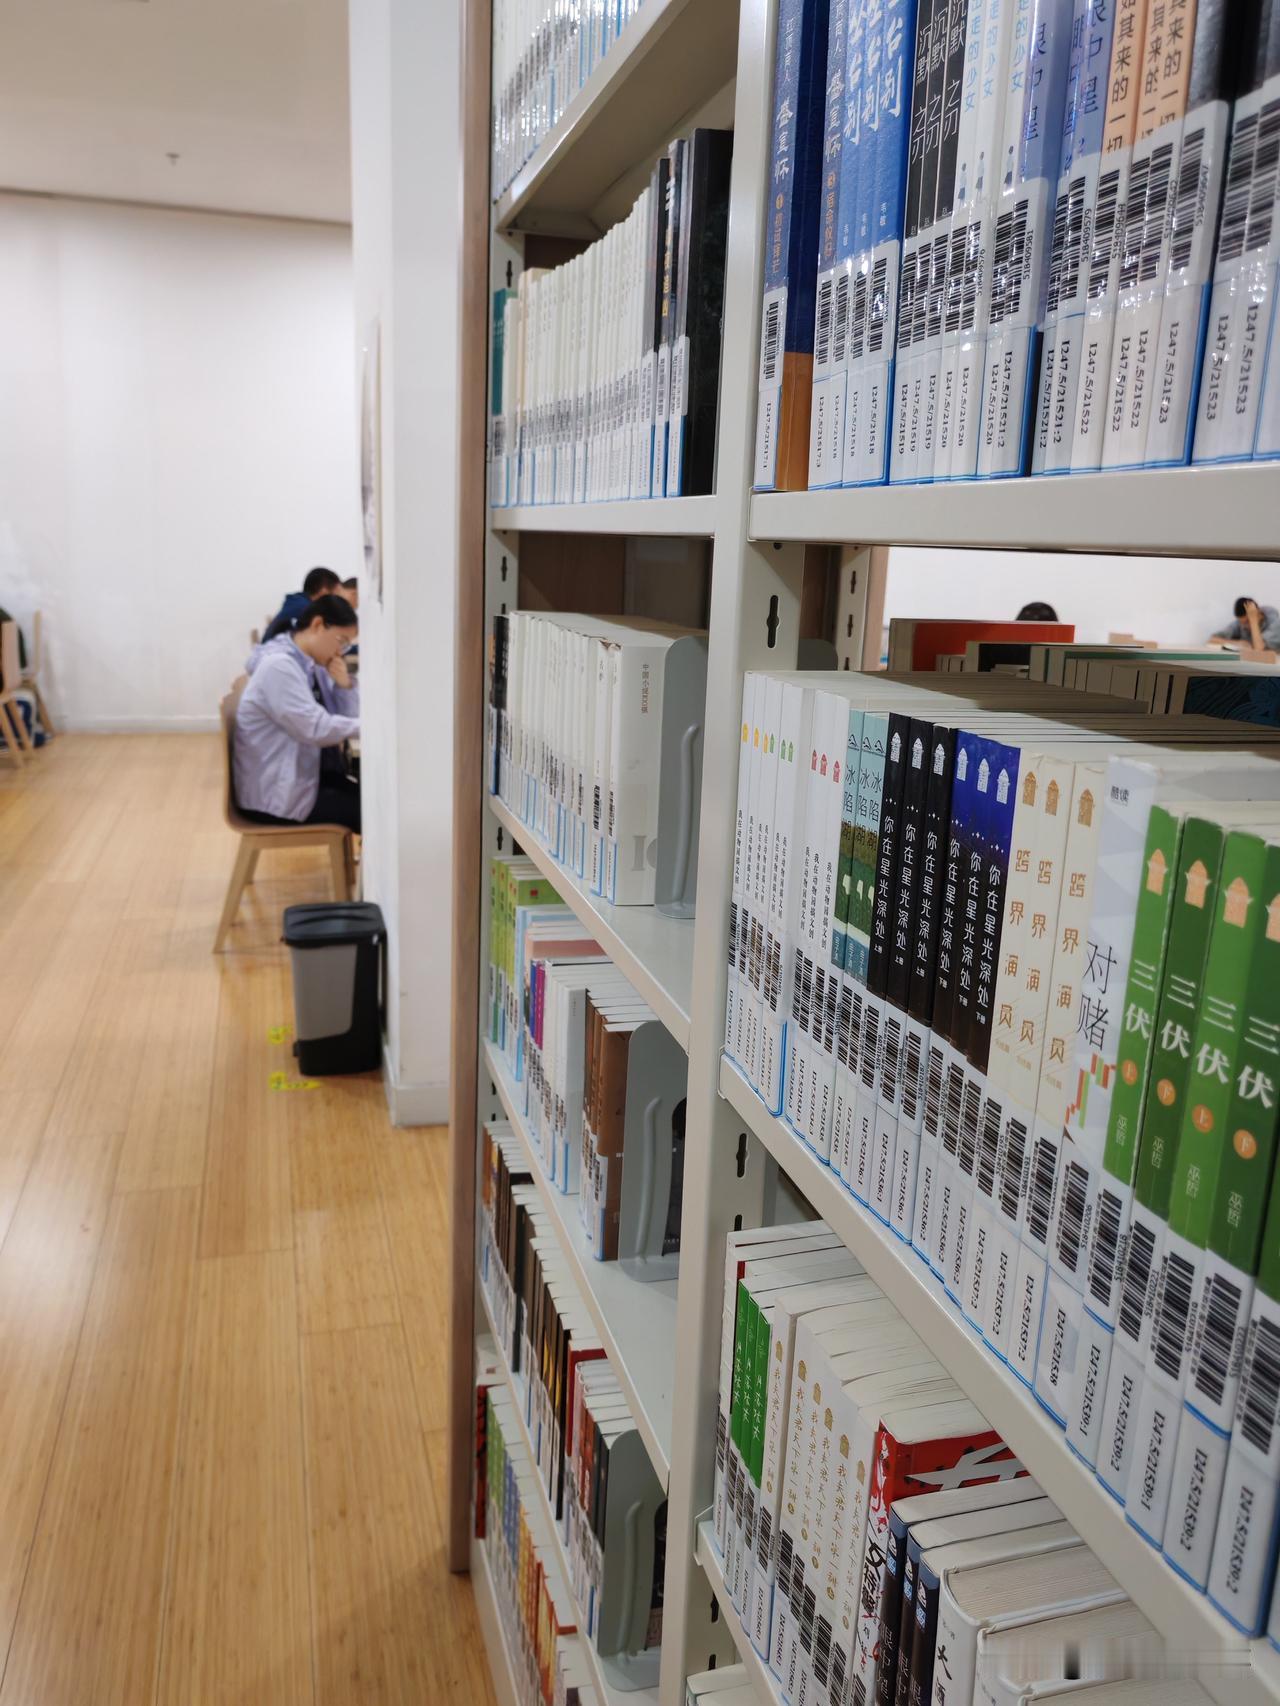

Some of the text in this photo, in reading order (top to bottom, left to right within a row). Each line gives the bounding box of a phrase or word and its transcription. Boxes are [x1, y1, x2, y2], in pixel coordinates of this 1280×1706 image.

[912, 23, 932, 164] 沉默之刃
[926, 9, 949, 155] 沉默之刃
[1023, 229, 1034, 280] 518409581
[1081, 208, 1091, 262] 518409579
[997, 351, 1012, 448] I247.5/21521:2
[1053, 340, 1070, 444] I247.5/21521:2
[1081, 342, 1097, 435] I247.5/21522
[1112, 336, 1130, 433] I247.5/21522
[1130, 330, 1149, 428] I247.5/21522
[1235, 303, 1259, 415] I247.5/21523
[875, 815, 894, 940] 你在星光深处
[896, 823, 916, 951] 你在星光深处
[917, 831, 937, 962] 你在星光深处
[940, 838, 960, 973] 你在星光深处
[959, 851, 981, 991] 你在星光深处
[976, 864, 1000, 1008] 你在星光深处
[999, 849, 1031, 1029] 跨界演员
[1019, 859, 1052, 1046] 跨界演员
[1050, 872, 1087, 1064] 跨界演员
[1076, 940, 1117, 1051] 对赌
[1125, 959, 1156, 1040] 三伏
[1161, 974, 1196, 1058] 三伏
[1196, 996, 1237, 1084] 三伏
[1237, 1015, 1280, 1109] 三伏
[972, 1228, 986, 1310] I247.5/21537:2
[992, 1251, 1008, 1336] I247.5/21537:2
[1018, 1274, 1034, 1362] I247.5/21537:2
[1050, 1307, 1066, 1387] I247.5/21538
[1080, 1343, 1101, 1437] I247.5/21539:1
[1111, 1375, 1133, 1472] I247.5/21539:2
[1141, 1409, 1165, 1511] I247.5/21539:1
[1180, 1448, 1208, 1552] I247.5/21539:2
[1226, 1484, 1254, 1596] I247.5/21539:2
